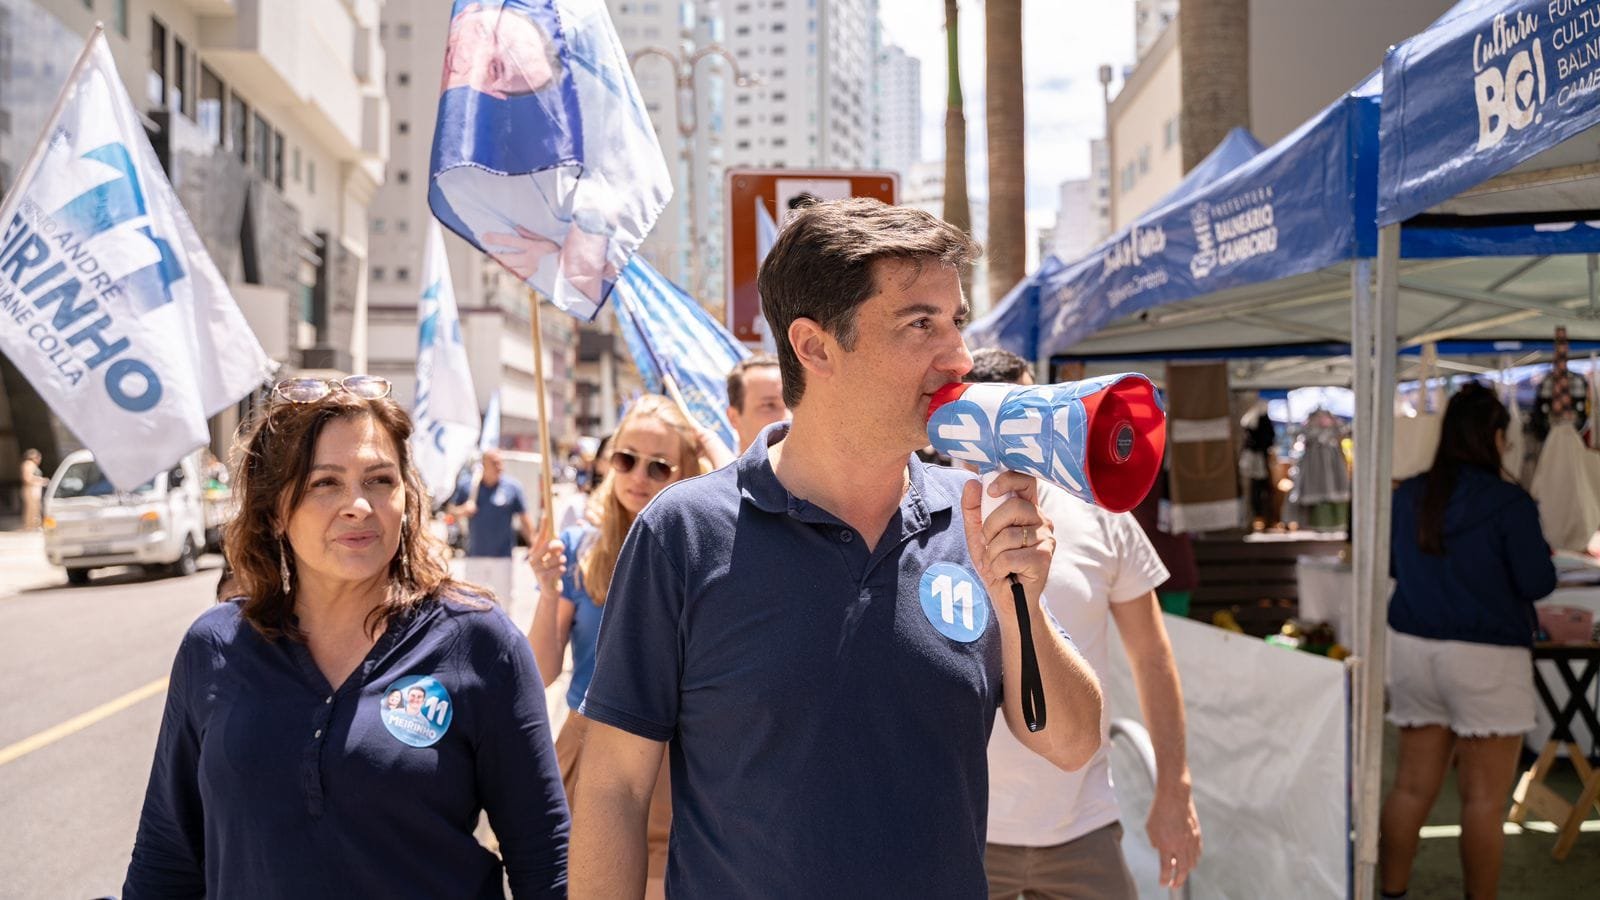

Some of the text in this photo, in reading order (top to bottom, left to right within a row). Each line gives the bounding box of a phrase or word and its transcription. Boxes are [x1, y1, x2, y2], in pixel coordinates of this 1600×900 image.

[1473, 11, 1538, 73] Cultura
[1558, 36, 1600, 80] BALN
[28, 323, 84, 386] COLLA
[931, 574, 974, 632] 11
[388, 714, 437, 740] MEIRINHO
[425, 696, 449, 726] 11
